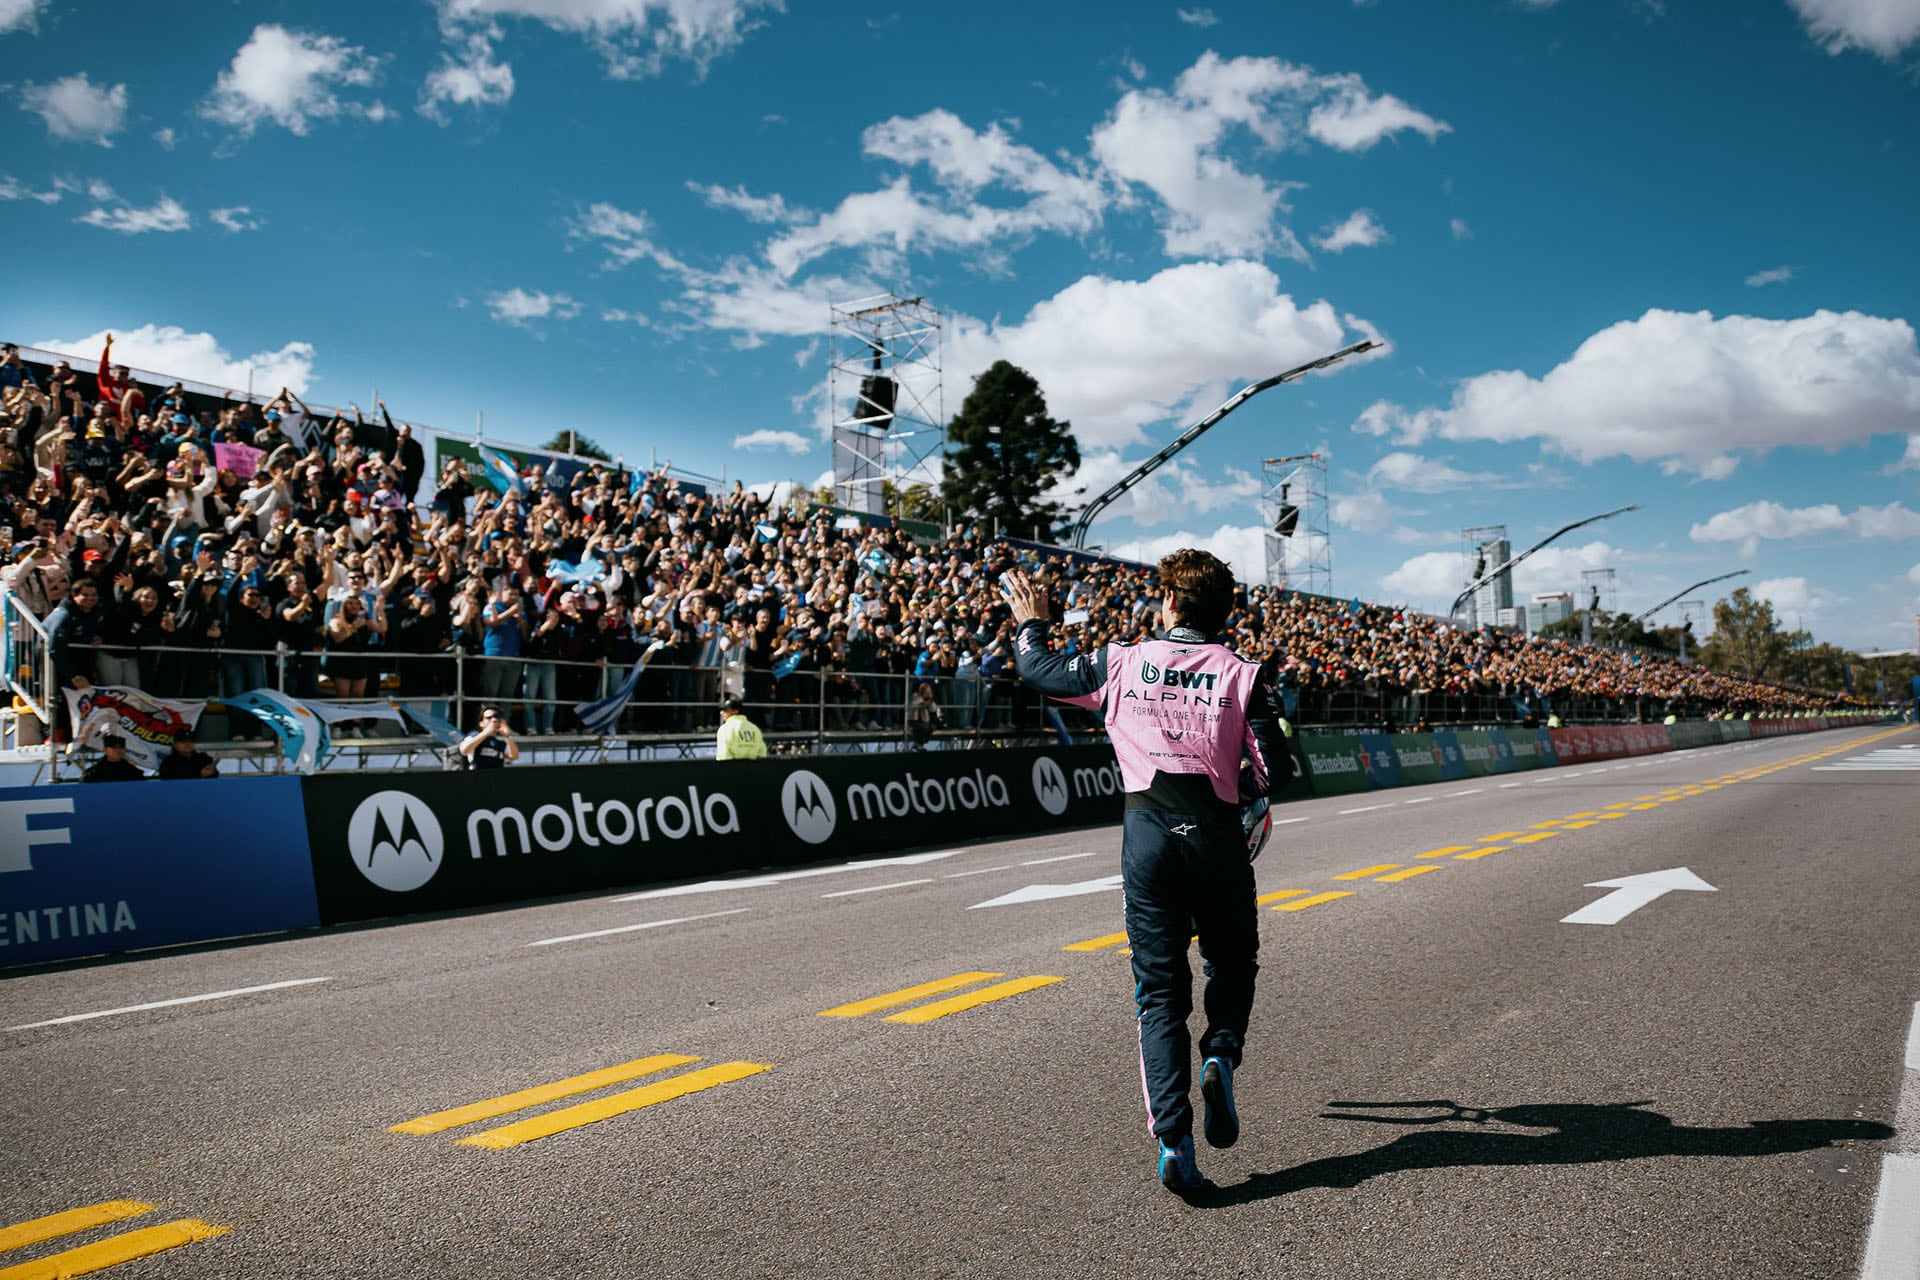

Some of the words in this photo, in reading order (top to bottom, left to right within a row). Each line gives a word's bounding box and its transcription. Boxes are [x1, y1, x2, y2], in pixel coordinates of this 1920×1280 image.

[1163, 668, 1217, 691] BWT
[1123, 689, 1233, 708] ALPINE
[1132, 706, 1169, 718] FORMULA
[1198, 713, 1221, 723] TEAM
[1308, 753, 1359, 775] Heineken
[1396, 747, 1435, 767] Heineken
[847, 768, 1010, 821] motorola
[467, 785, 741, 859] motorola
